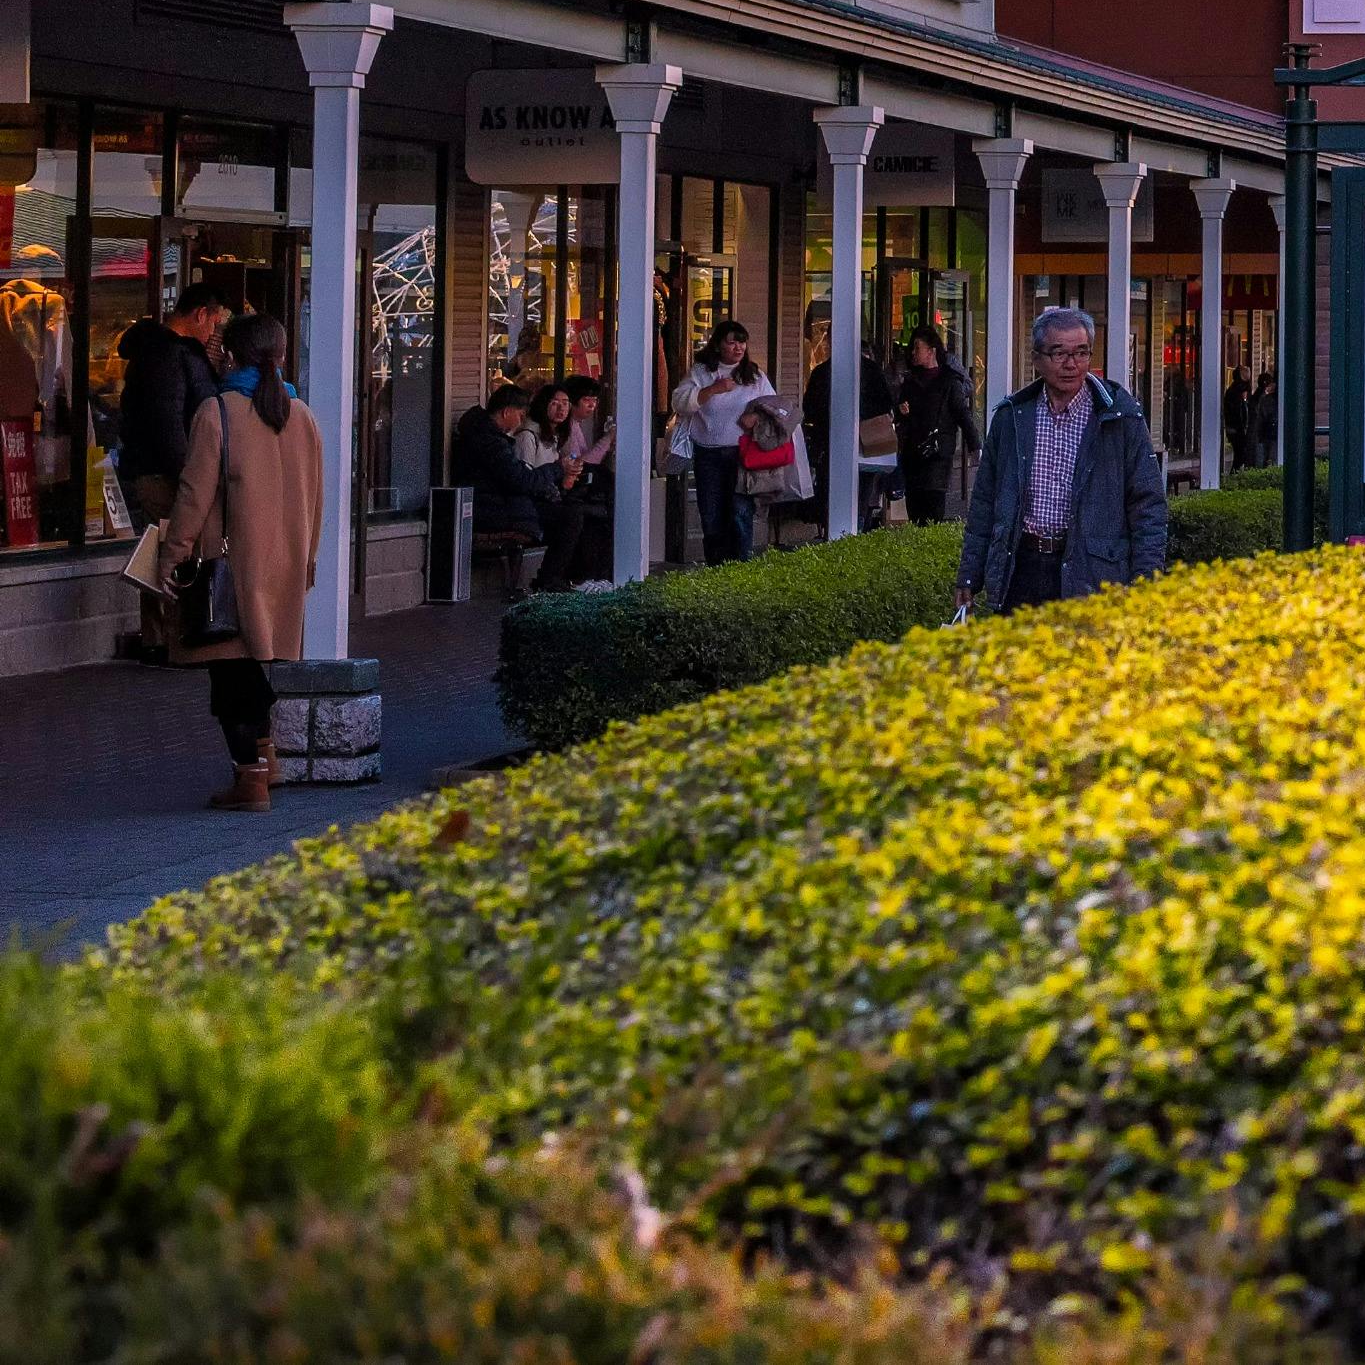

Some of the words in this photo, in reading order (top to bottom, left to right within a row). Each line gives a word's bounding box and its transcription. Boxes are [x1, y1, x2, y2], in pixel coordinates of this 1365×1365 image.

[479, 106, 507, 130] AS
[515, 105, 591, 129] KNOW
[600, 107, 616, 129] A
[520, 136, 585, 147] outlet
[10, 471, 28, 494] TAX
[11, 496, 33, 520] FREE
